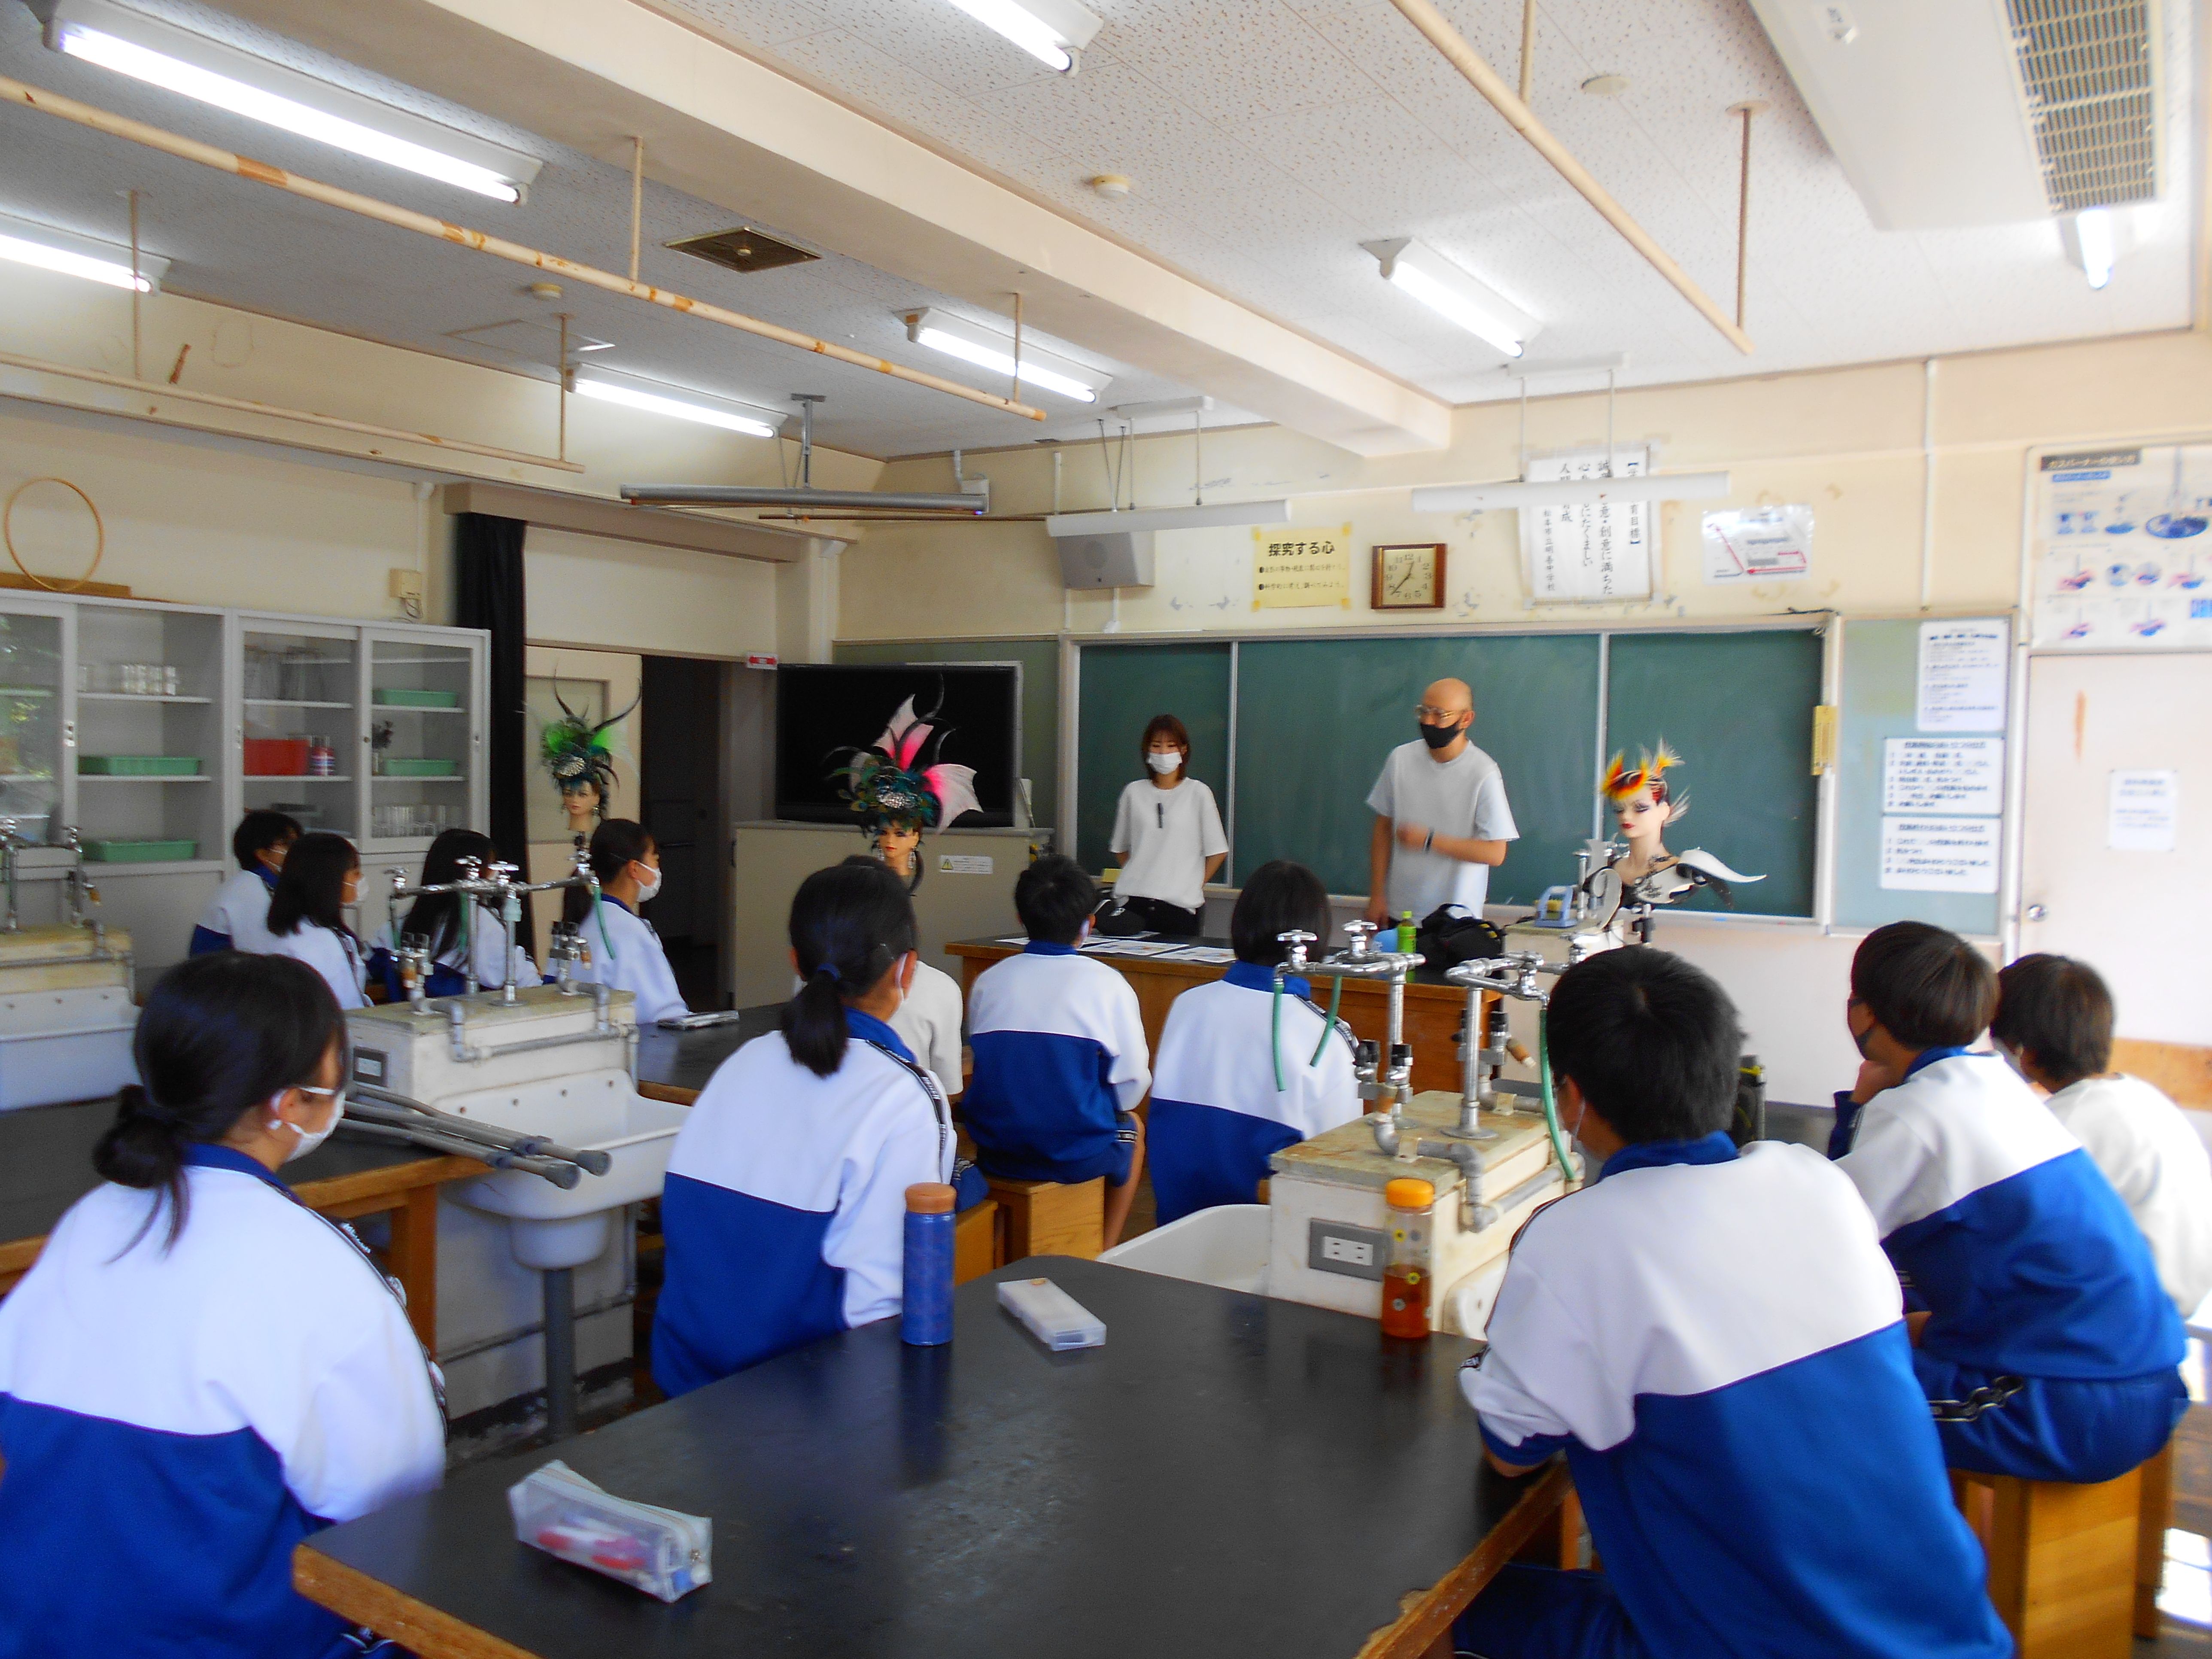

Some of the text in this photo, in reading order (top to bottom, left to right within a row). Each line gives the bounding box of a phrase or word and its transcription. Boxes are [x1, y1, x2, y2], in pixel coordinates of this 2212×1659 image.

[1268, 540, 1335, 557] 探究する心
